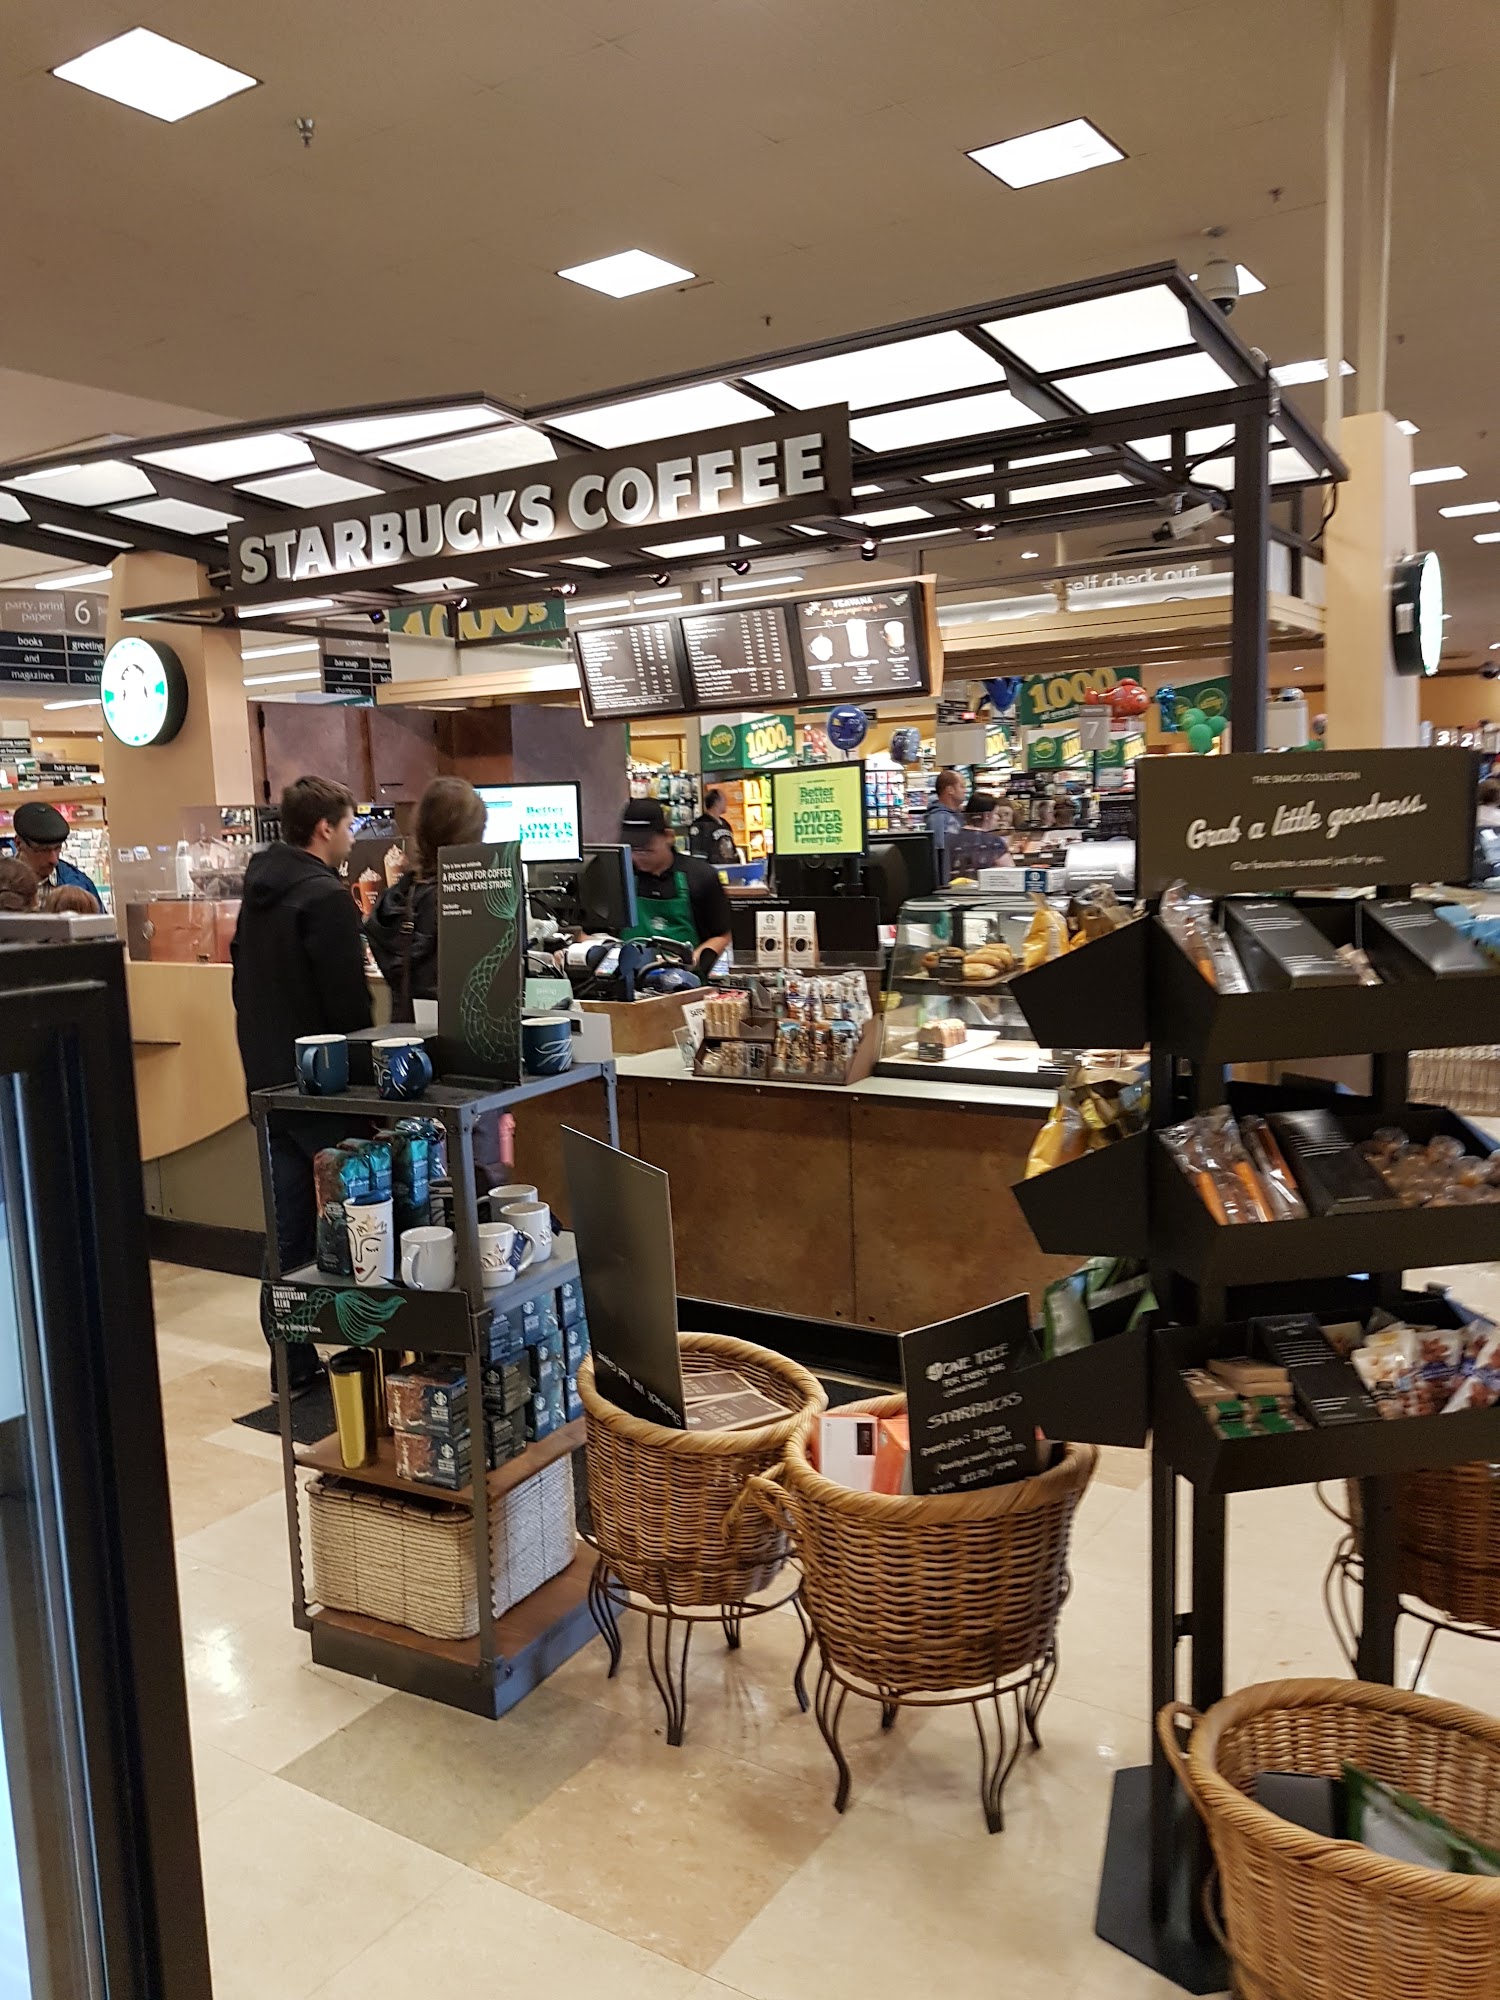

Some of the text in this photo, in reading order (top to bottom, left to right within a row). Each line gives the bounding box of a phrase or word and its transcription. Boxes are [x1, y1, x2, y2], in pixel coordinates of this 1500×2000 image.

[240, 433, 825, 585] STARBUCKS COFFEE
[1101, 568, 1157, 588] check
[39, 600, 65, 611] print
[75, 599, 91, 624] 6
[21, 613, 52, 622] paper
[17, 635, 43, 647] books
[72, 641, 104, 653] greeting
[24, 654, 40, 663] and
[93, 657, 104, 667] an
[11, 671, 55, 681] magazines
[341, 673, 354, 681] and
[1086, 721, 1099, 739] 7
[1436, 731, 1450, 746] 3
[1460, 732, 1474, 747] 2
[799, 786, 835, 798] Better
[800, 796, 835, 806] PRODUCE
[793, 809, 842, 824] LOWER
[1186, 791, 1428, 850] Grab a little goodness.
[793, 821, 843, 843] prices
[442, 867, 513, 882] A PASSION FOR COFFEE
[470, 880, 487, 891] YEARS
[488, 878, 512, 889] STRONG
[273, 1299, 291, 1309] BLEND
[942, 1356, 973, 1376] ONE
